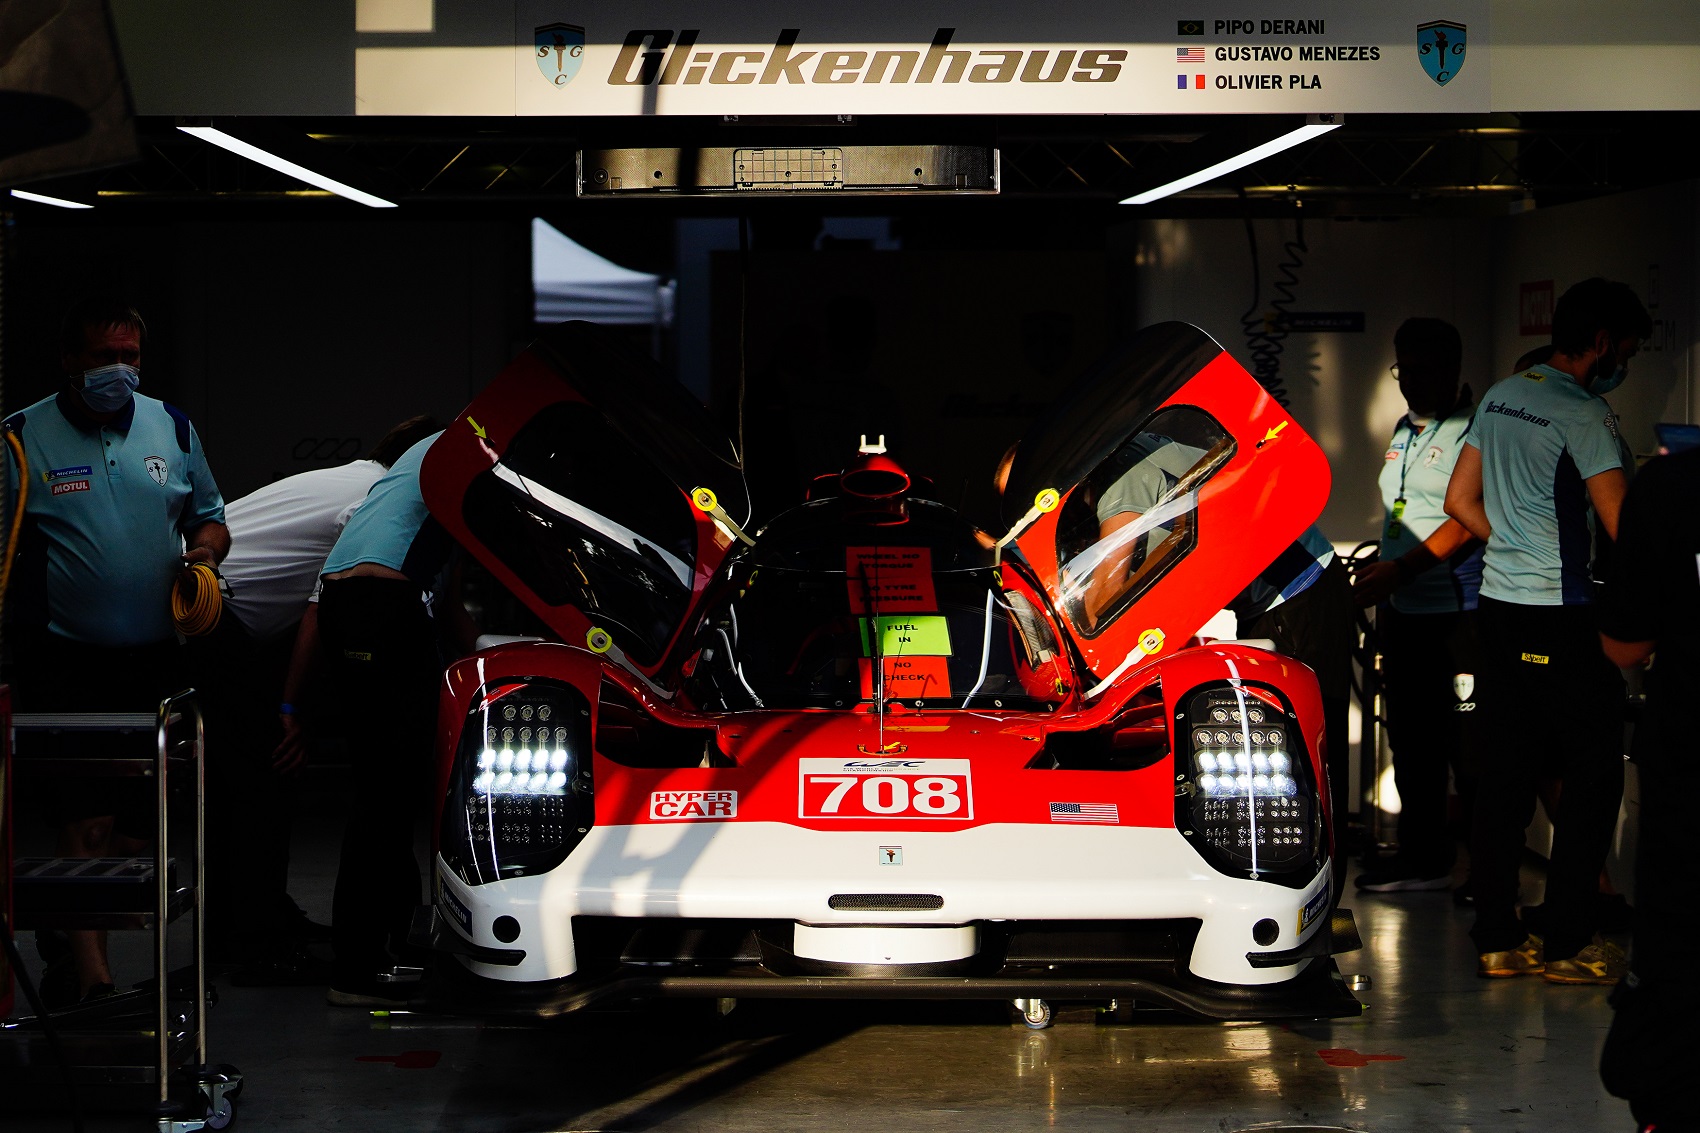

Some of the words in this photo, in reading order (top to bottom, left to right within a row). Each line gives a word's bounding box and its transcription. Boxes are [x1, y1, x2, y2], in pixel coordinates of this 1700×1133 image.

[1214, 19, 1255, 35] PIPO
[1260, 19, 1326, 35] DERANI
[607, 28, 1128, 85] Glickenhaus
[1214, 46, 1293, 61] GUSTAVO
[1299, 46, 1381, 61] MENEZES
[1214, 74, 1284, 90] OLIVIER
[1289, 74, 1322, 90] PLA
[56, 468, 88, 477] MICHELIN
[53, 481, 88, 494] MOTUL
[654, 791, 733, 802] HYPER
[809, 775, 961, 815] 708
[654, 801, 732, 817] CAR
